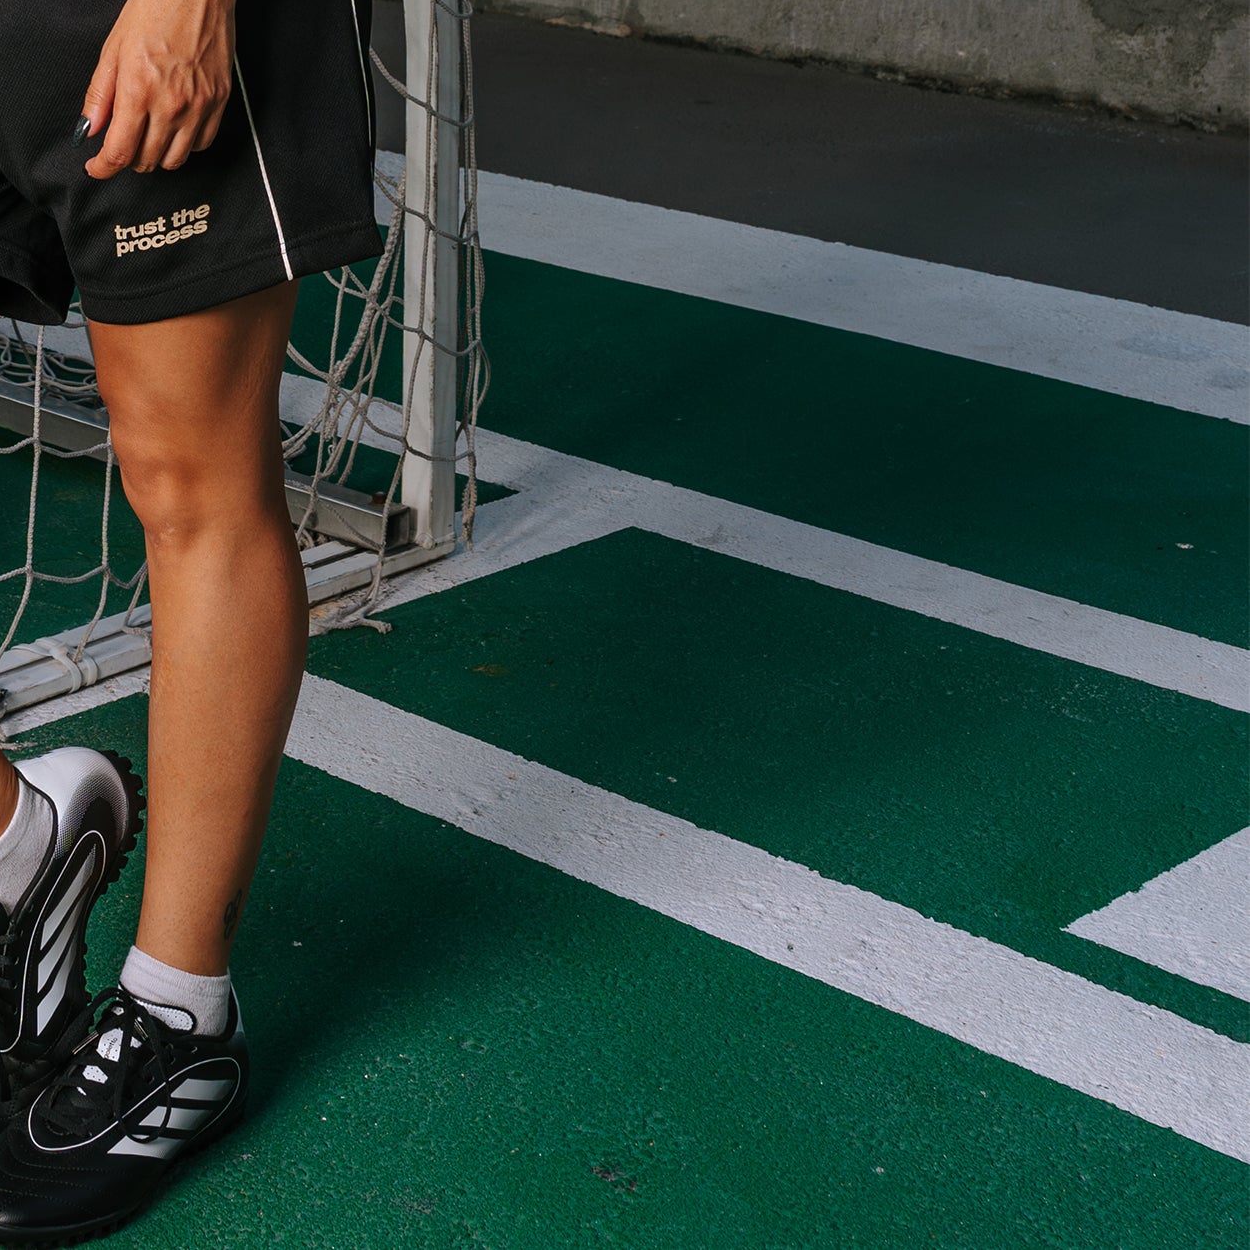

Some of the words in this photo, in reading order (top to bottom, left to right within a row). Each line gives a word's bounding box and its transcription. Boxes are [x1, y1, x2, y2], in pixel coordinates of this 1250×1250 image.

[114, 216, 167, 240] trust
[171, 203, 211, 228] the
[115, 220, 208, 258] process
